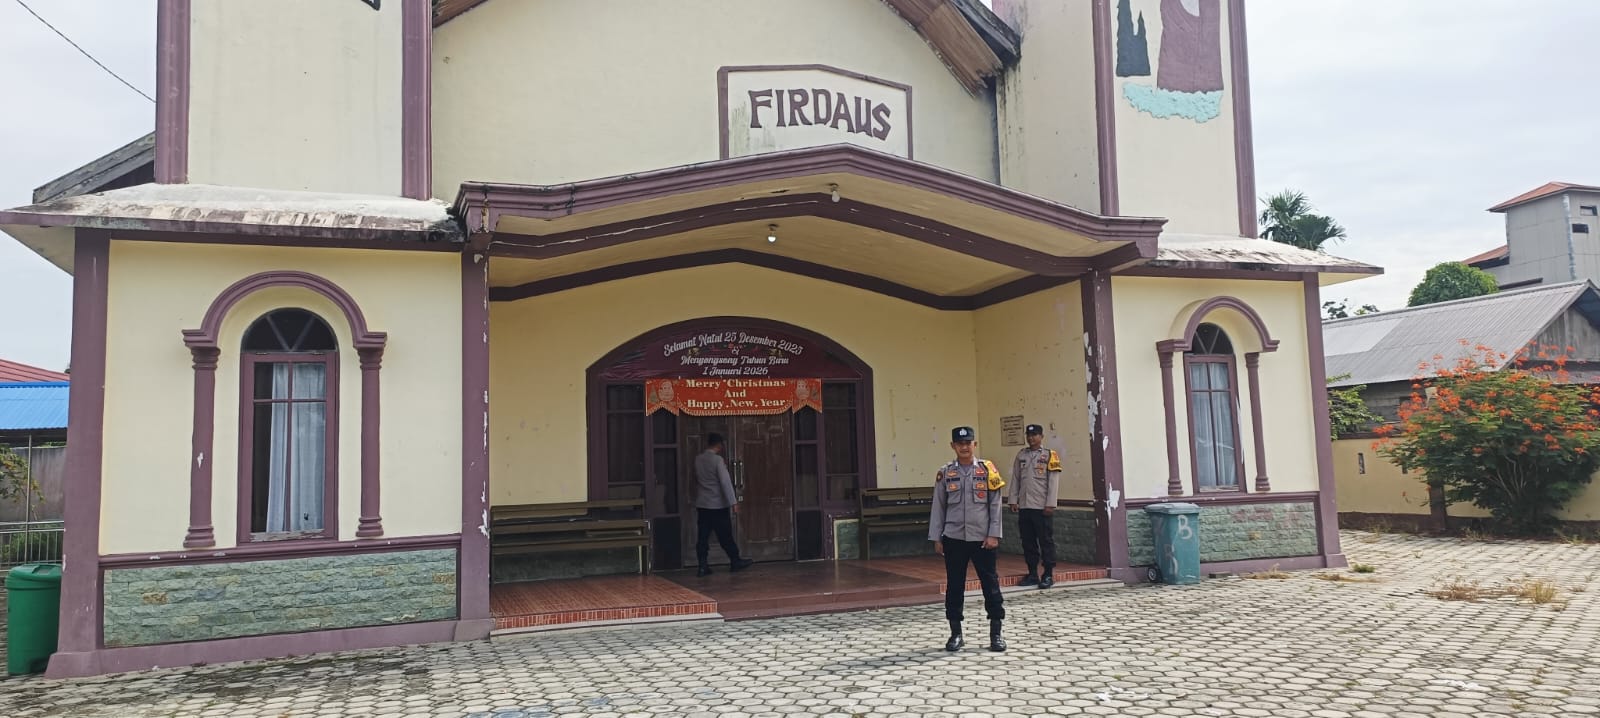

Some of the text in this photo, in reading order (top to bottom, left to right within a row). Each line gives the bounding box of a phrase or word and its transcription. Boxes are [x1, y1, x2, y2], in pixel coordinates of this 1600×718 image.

[747, 88, 892, 141] FIRDAUS
[663, 331, 804, 357] Selamat Natal 25 Desember 2025
[731, 346, 740, 355] &
[740, 355, 767, 365] Tahun
[768, 356, 789, 365] Baru
[702, 366, 769, 376] 1 Januari 2026
[685, 379, 786, 389] Merry Christmas
[724, 389, 747, 398] And
[687, 399, 724, 410] Happy
[760, 398, 786, 407] Year
